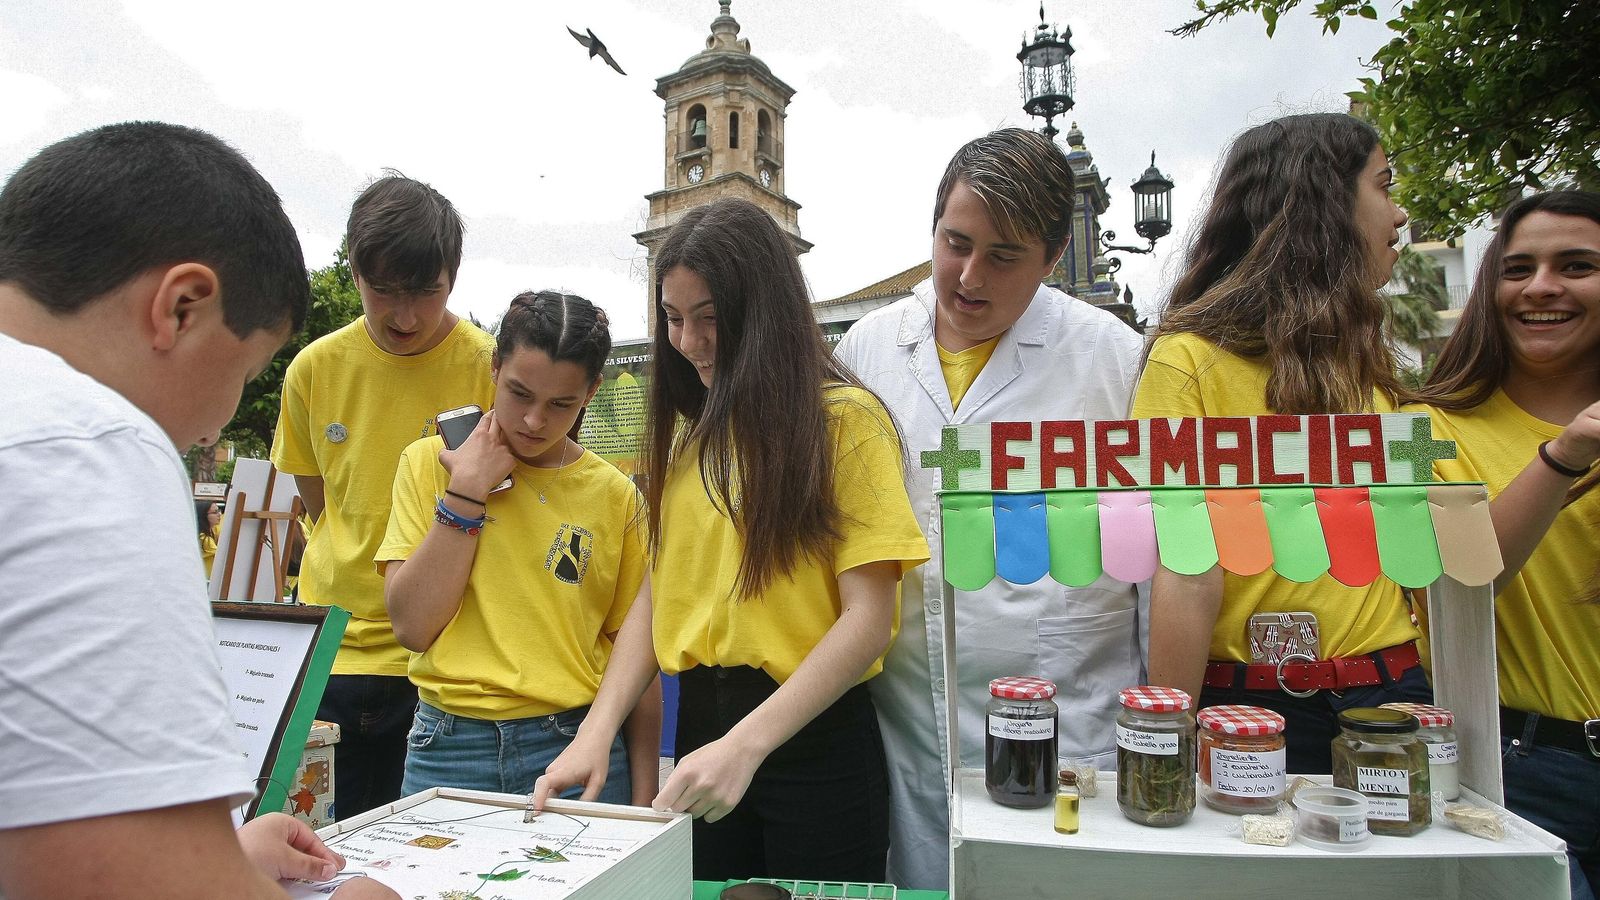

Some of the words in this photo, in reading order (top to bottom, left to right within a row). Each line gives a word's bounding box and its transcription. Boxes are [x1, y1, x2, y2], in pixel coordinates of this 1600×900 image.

[990, 414, 1388, 490] FARMACIA
[1359, 768, 1397, 778] MIRTO
[1400, 770, 1407, 778] Y
[1217, 780, 1241, 792] Fecha:
[1360, 783, 1401, 793] MENTA
